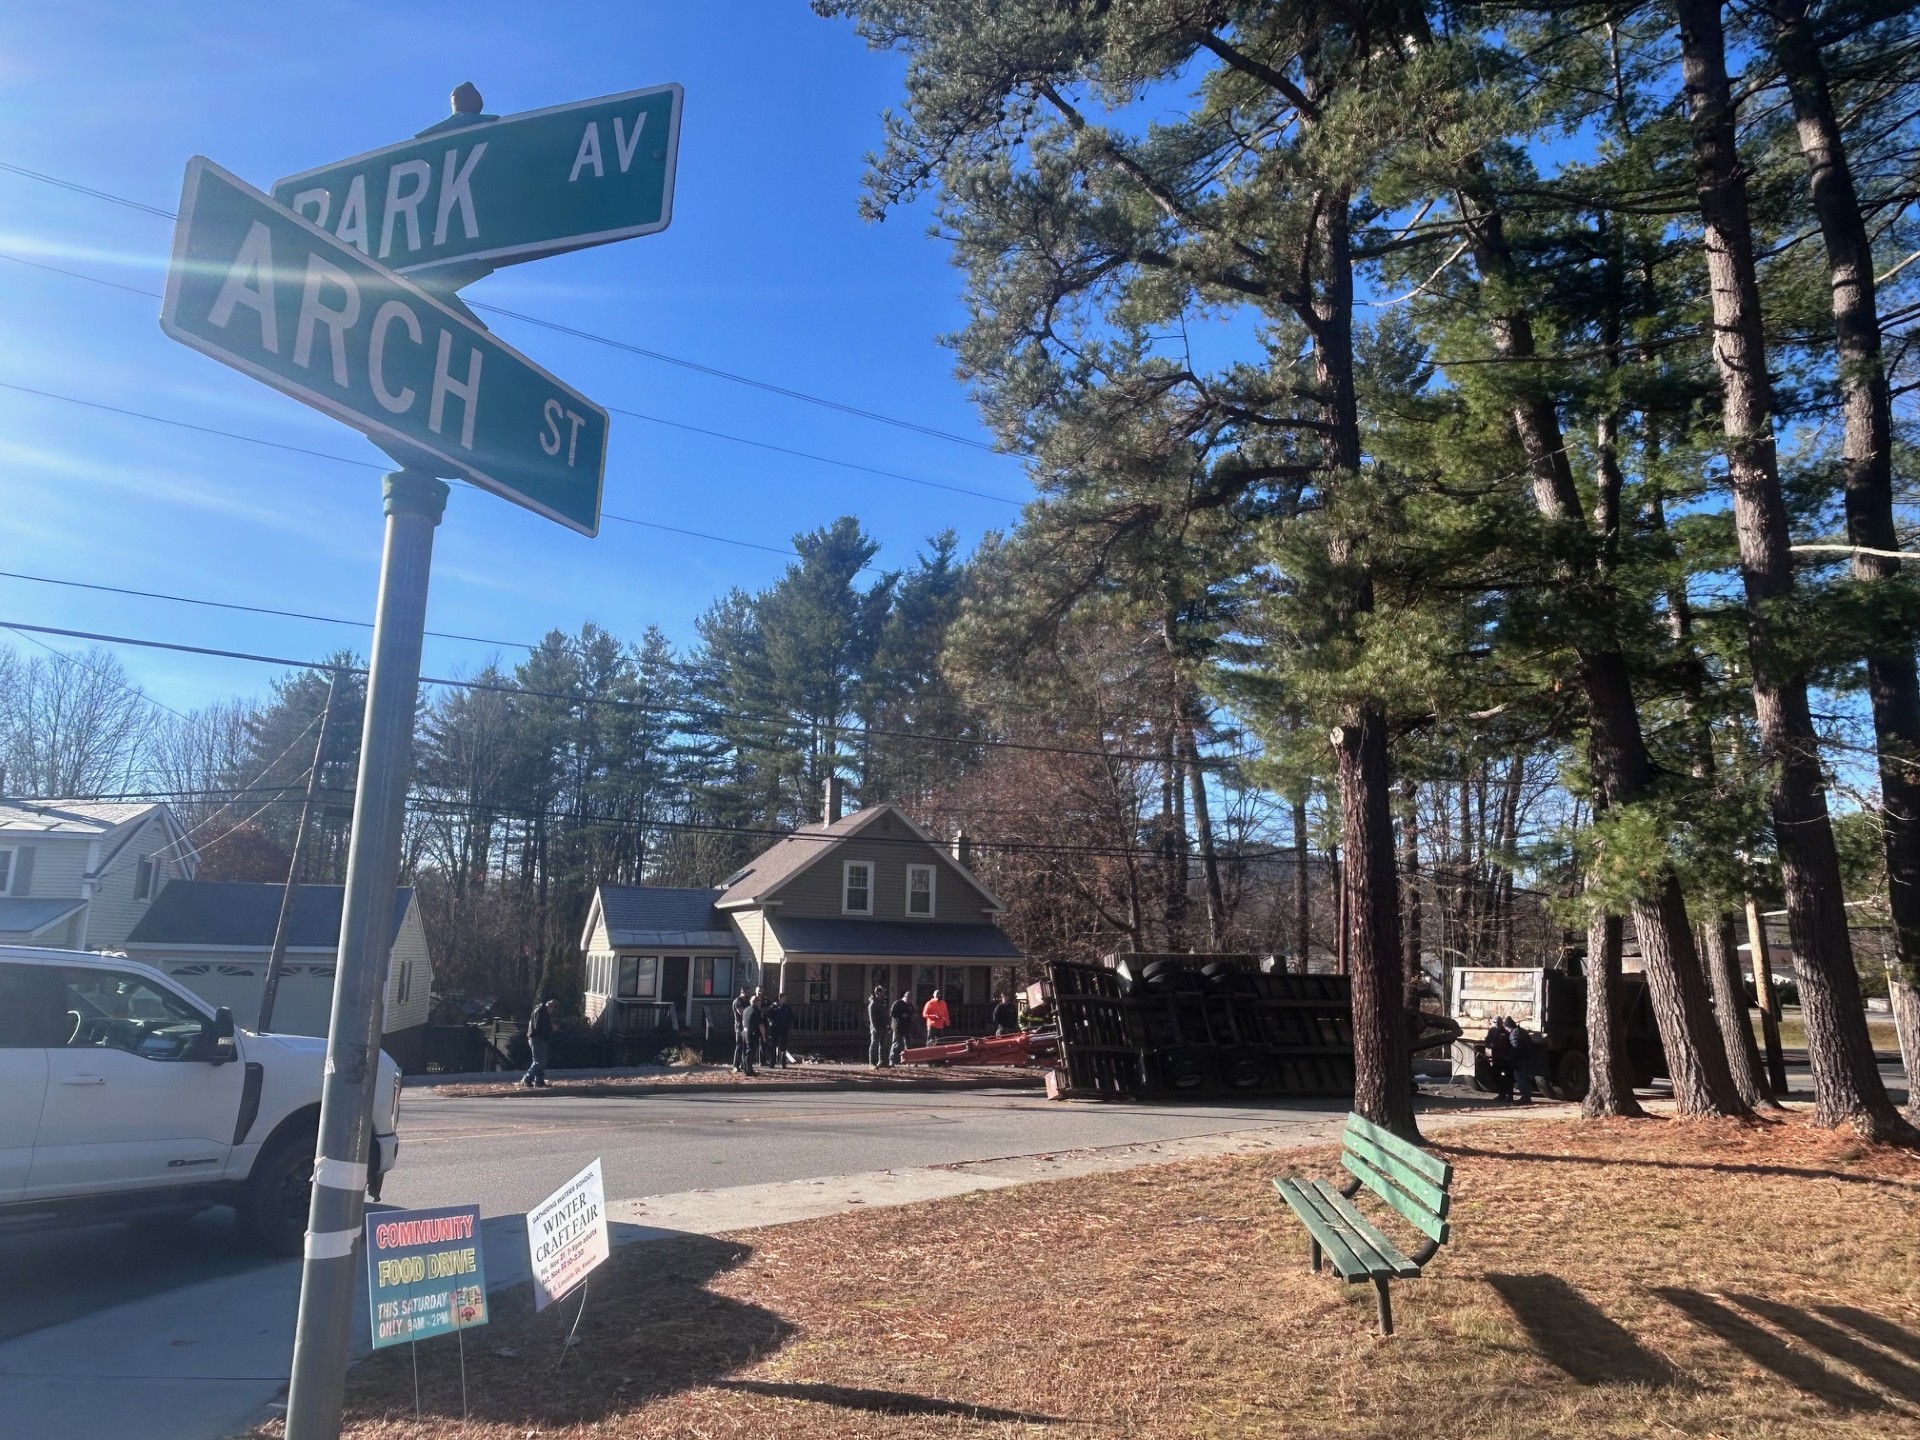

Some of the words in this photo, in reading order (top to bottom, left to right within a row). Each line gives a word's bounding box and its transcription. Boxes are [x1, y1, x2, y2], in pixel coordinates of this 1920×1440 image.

[568, 111, 648, 182] AV
[208, 219, 483, 450] ARCH
[539, 398, 587, 467] ST
[376, 1214, 474, 1249] COMMUNITY
[536, 1224, 570, 1262] CRAFT
[572, 1204, 598, 1235] FAIR
[543, 1192, 587, 1235] WINTER
[379, 1256, 425, 1288] FOOD
[427, 1248, 476, 1279] DRIVE
[378, 1301, 399, 1319] THIS
[401, 1292, 448, 1315] SATURDAY
[379, 1319, 402, 1338] ONLY
[407, 1317, 425, 1332] 9AM
[432, 1311, 449, 1327] 2PM
